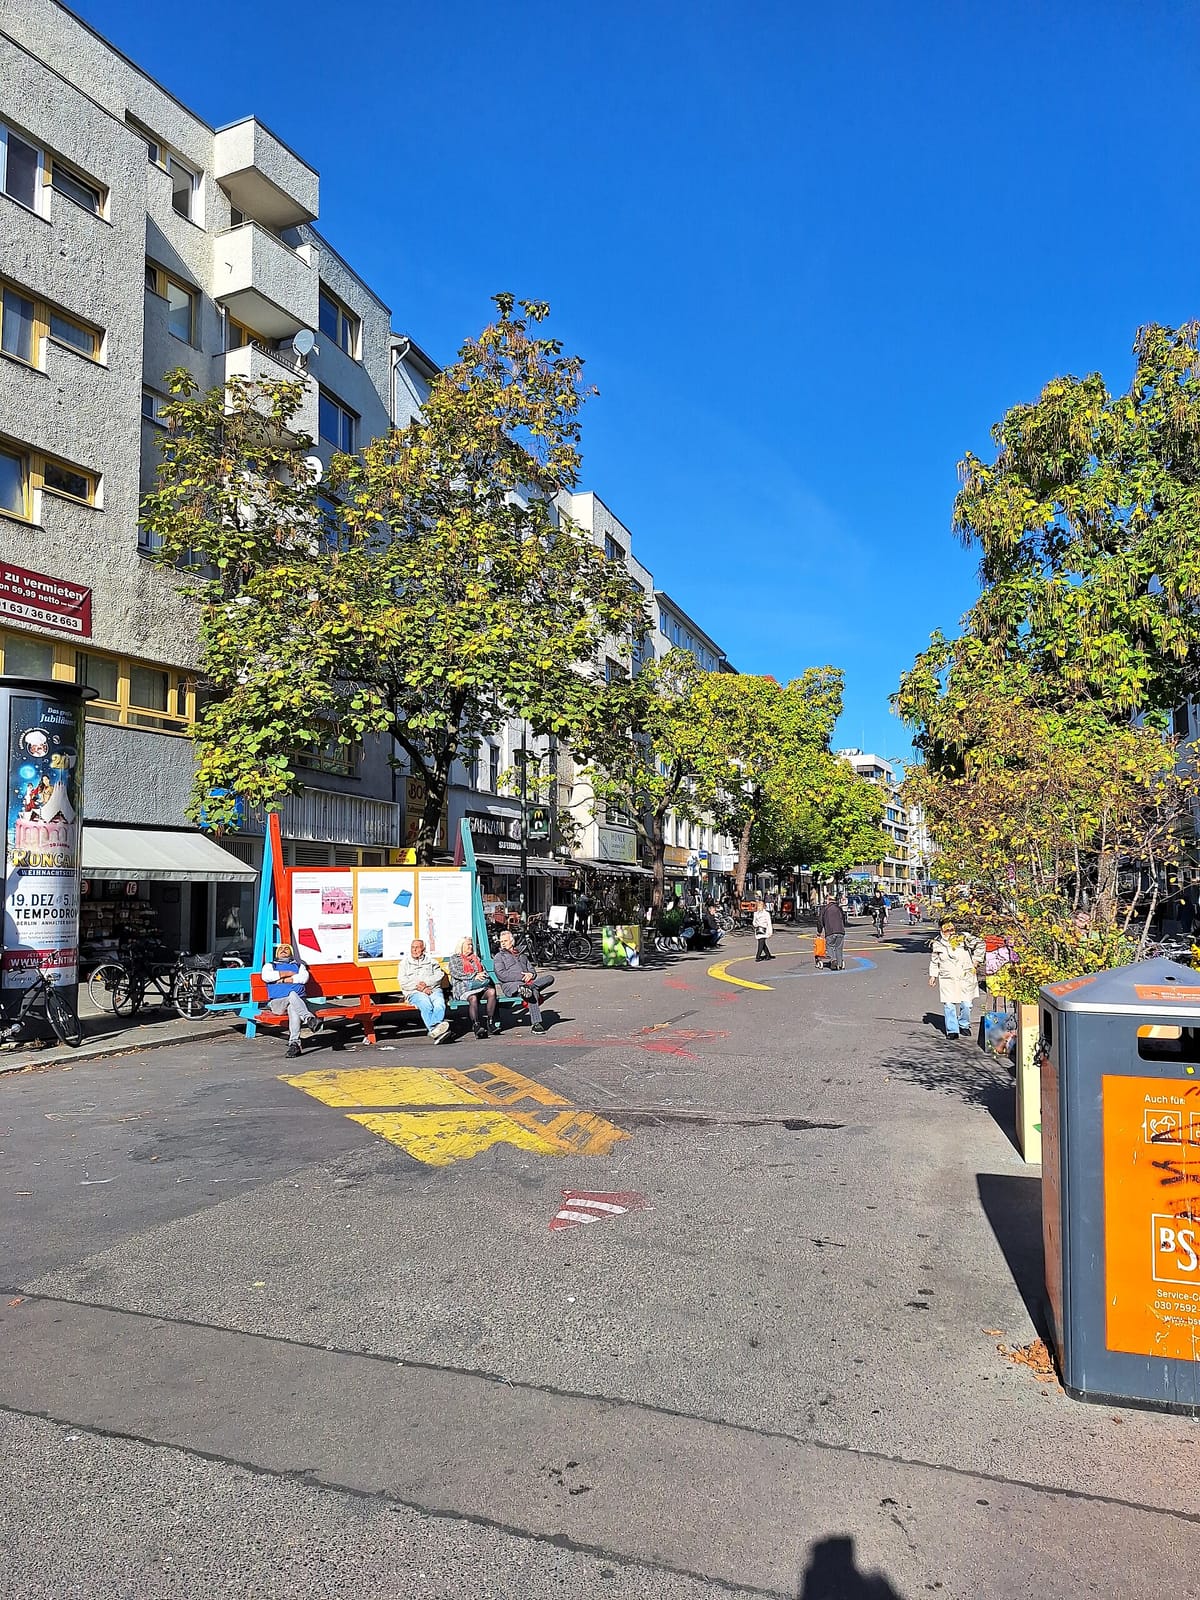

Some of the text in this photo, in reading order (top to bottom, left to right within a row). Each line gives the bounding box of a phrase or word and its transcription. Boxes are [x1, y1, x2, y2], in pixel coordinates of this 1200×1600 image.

[4, 572, 83, 601] zu vermieten
[11, 585, 36, 598] 59,99
[38, 594, 60, 605] netto
[10, 603, 23, 614] 63
[31, 609, 43, 619] 36
[45, 613, 58, 623] 62
[60, 616, 78, 628] 663
[11, 893, 28, 906] 19.
[31, 893, 54, 906] DEZ
[1144, 1093, 1168, 1104] Auch
[1154, 1300, 1172, 1310] 030
